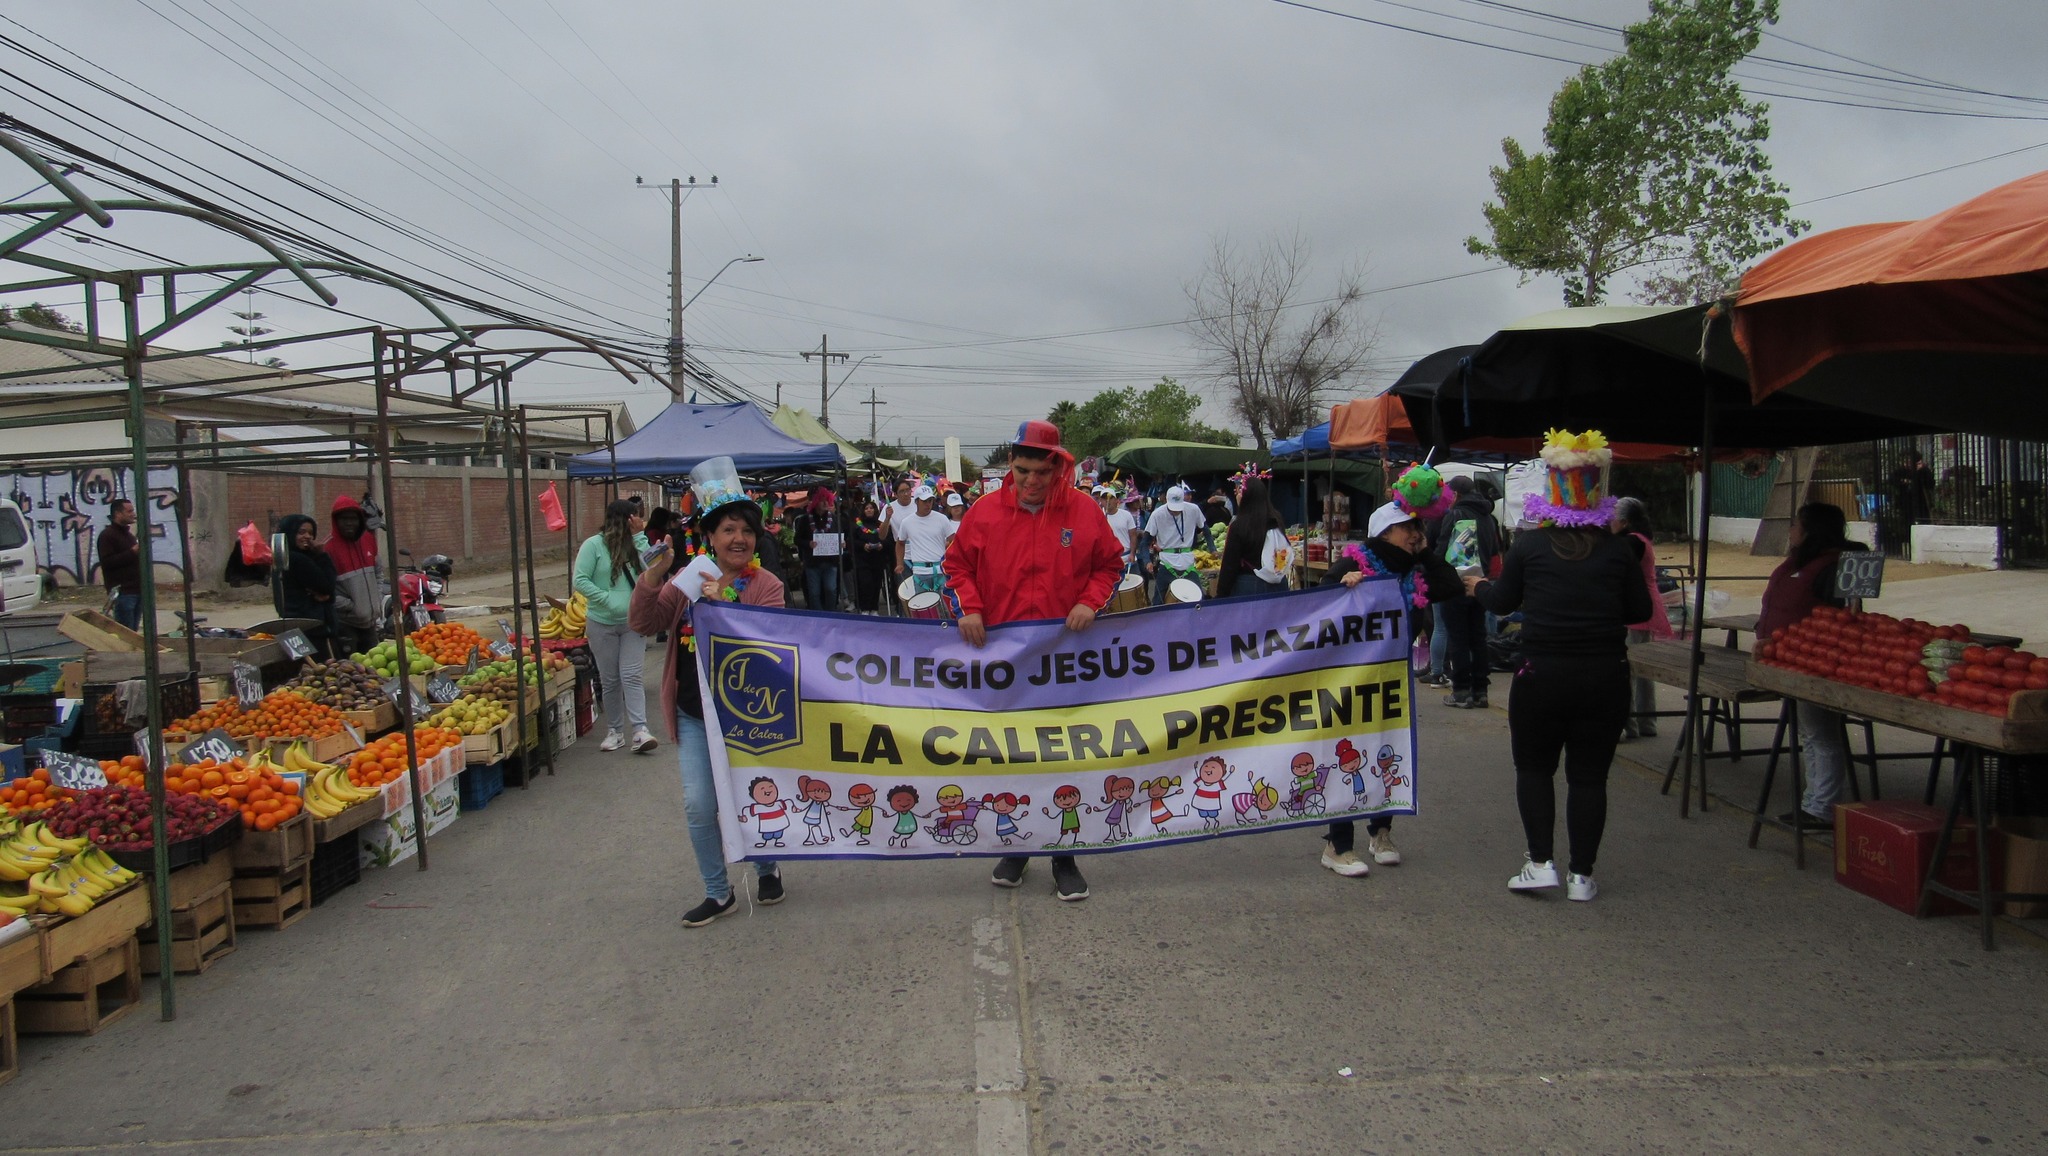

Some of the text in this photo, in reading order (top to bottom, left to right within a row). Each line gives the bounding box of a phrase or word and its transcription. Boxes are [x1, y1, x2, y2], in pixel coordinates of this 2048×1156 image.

[826, 609, 1403, 691] COLEGIO JESÚS DE NAZARET
[725, 724, 785, 741] La Calera
[829, 679, 1403, 766] LA CALERA PRESENTE
